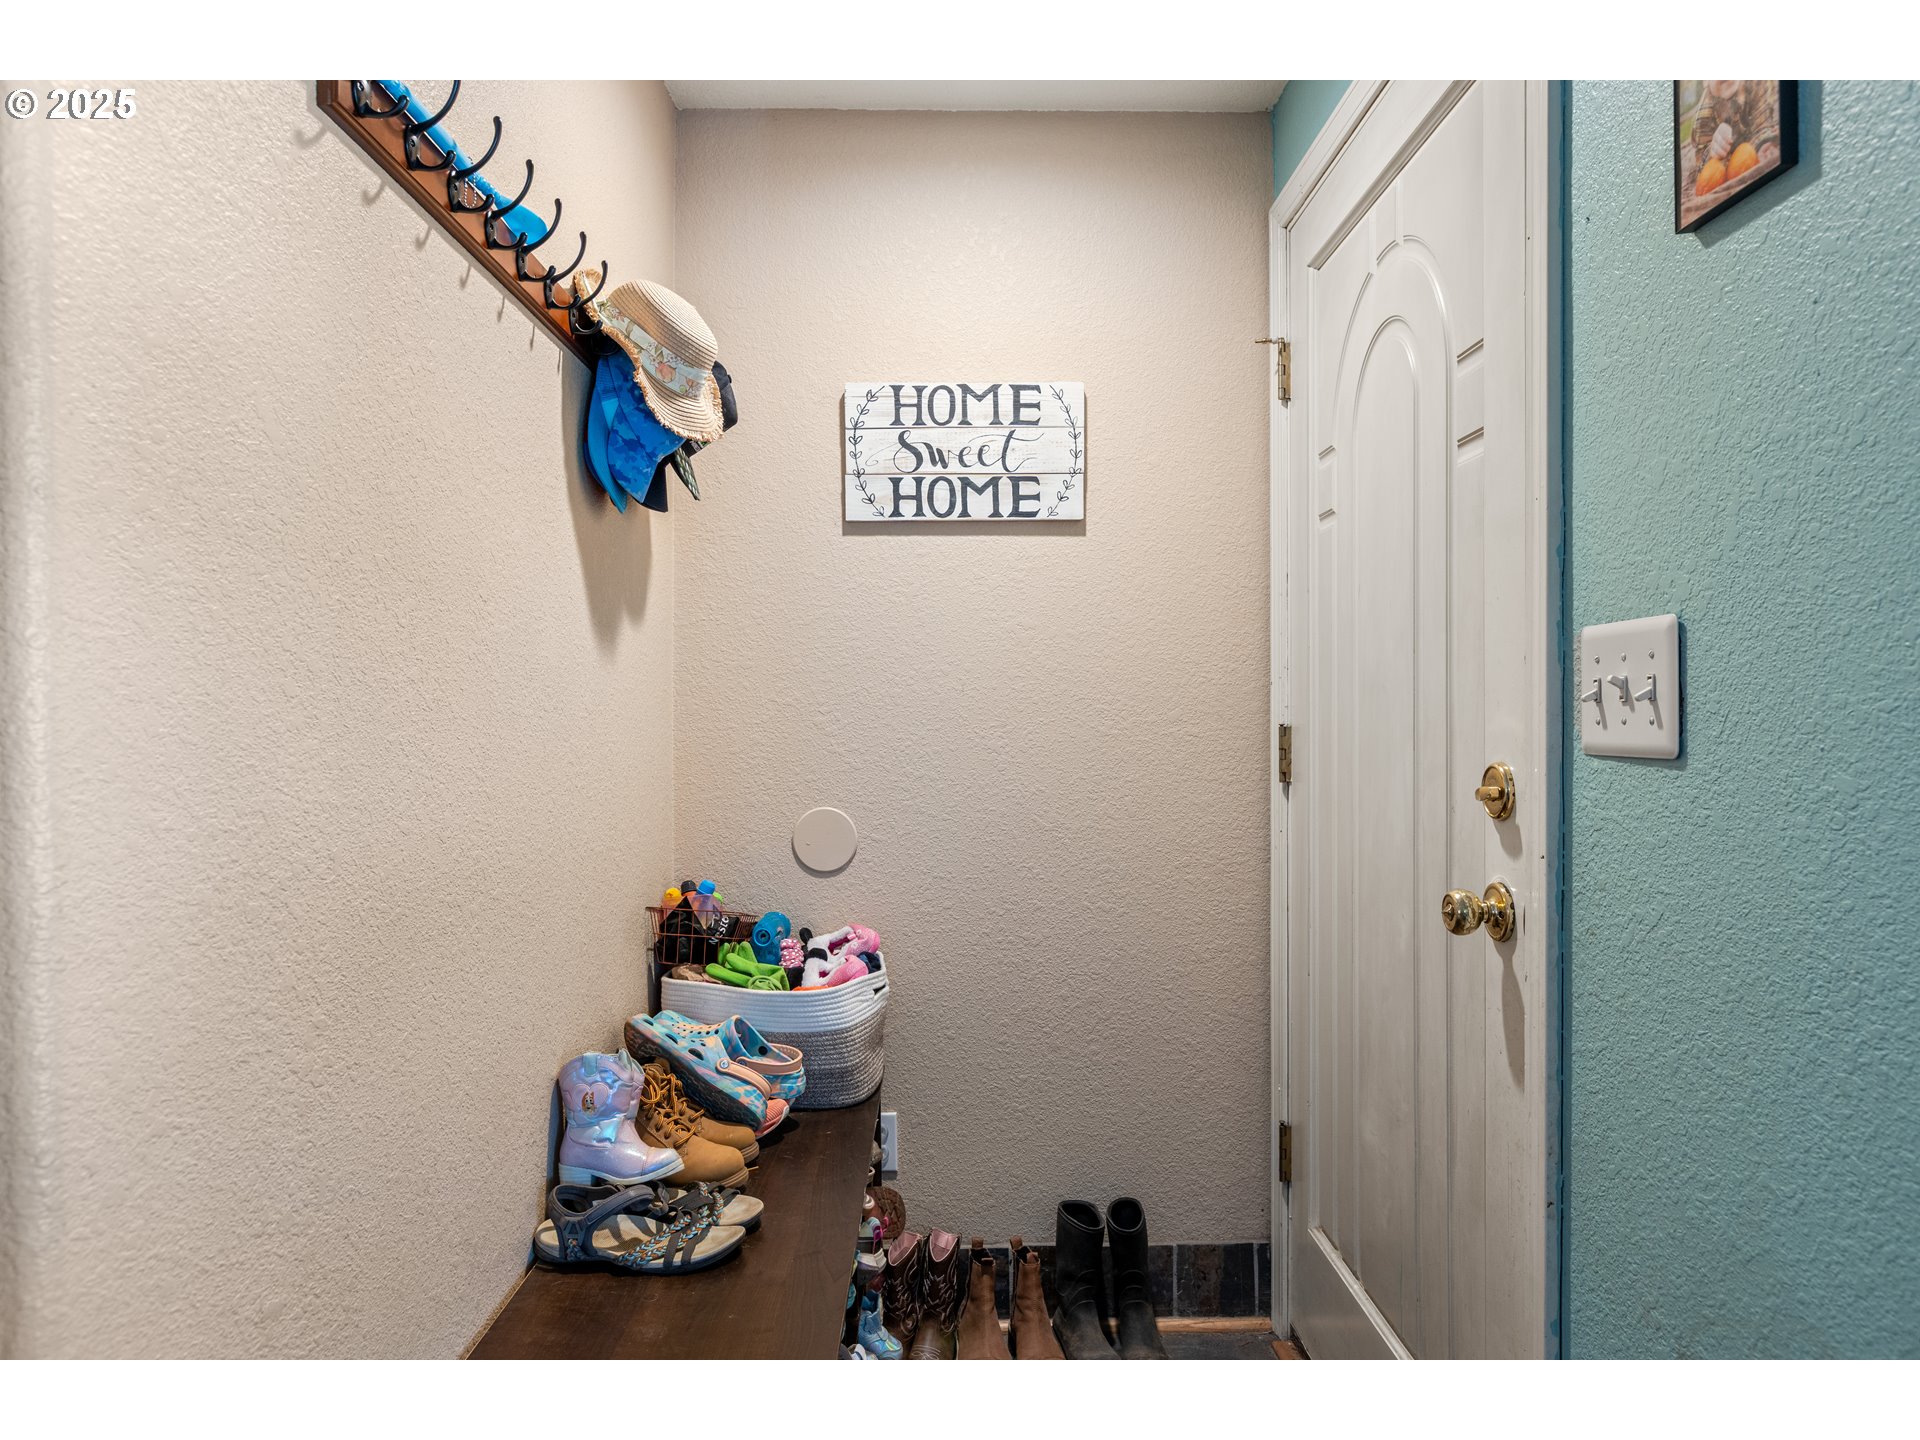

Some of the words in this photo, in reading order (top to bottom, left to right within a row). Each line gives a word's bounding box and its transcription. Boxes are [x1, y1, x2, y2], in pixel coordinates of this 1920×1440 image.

[889, 383, 1042, 426] HOME
[865, 429, 1046, 473] Sweet
[888, 475, 1042, 519] HOME
